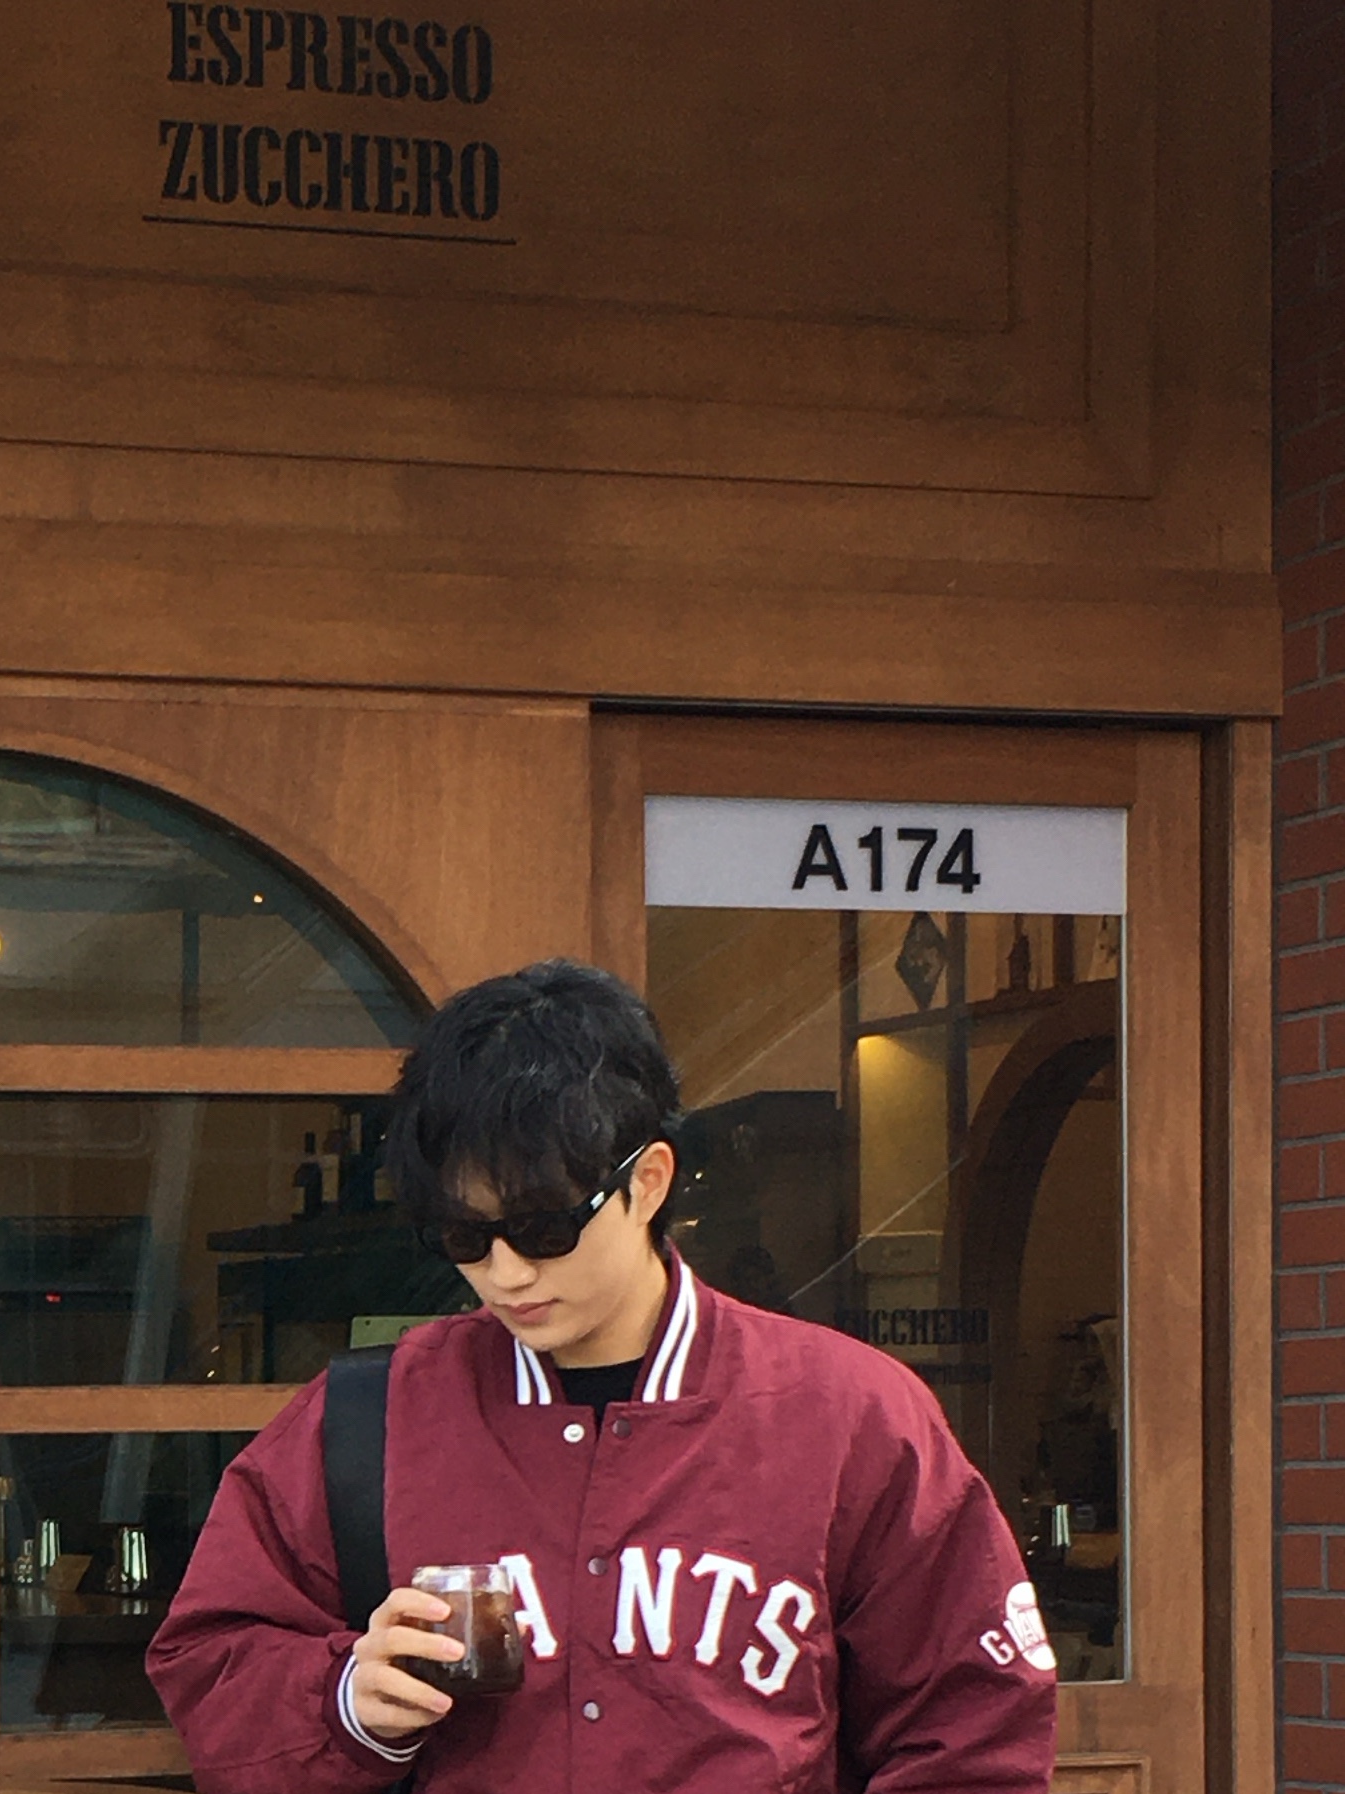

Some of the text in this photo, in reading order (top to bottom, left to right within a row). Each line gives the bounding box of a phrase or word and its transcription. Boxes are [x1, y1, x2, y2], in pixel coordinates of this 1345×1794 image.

[167, 1, 493, 105] ESPRESSO
[159, 119, 500, 222] ZUCCHERO
[792, 824, 981, 894] A174
